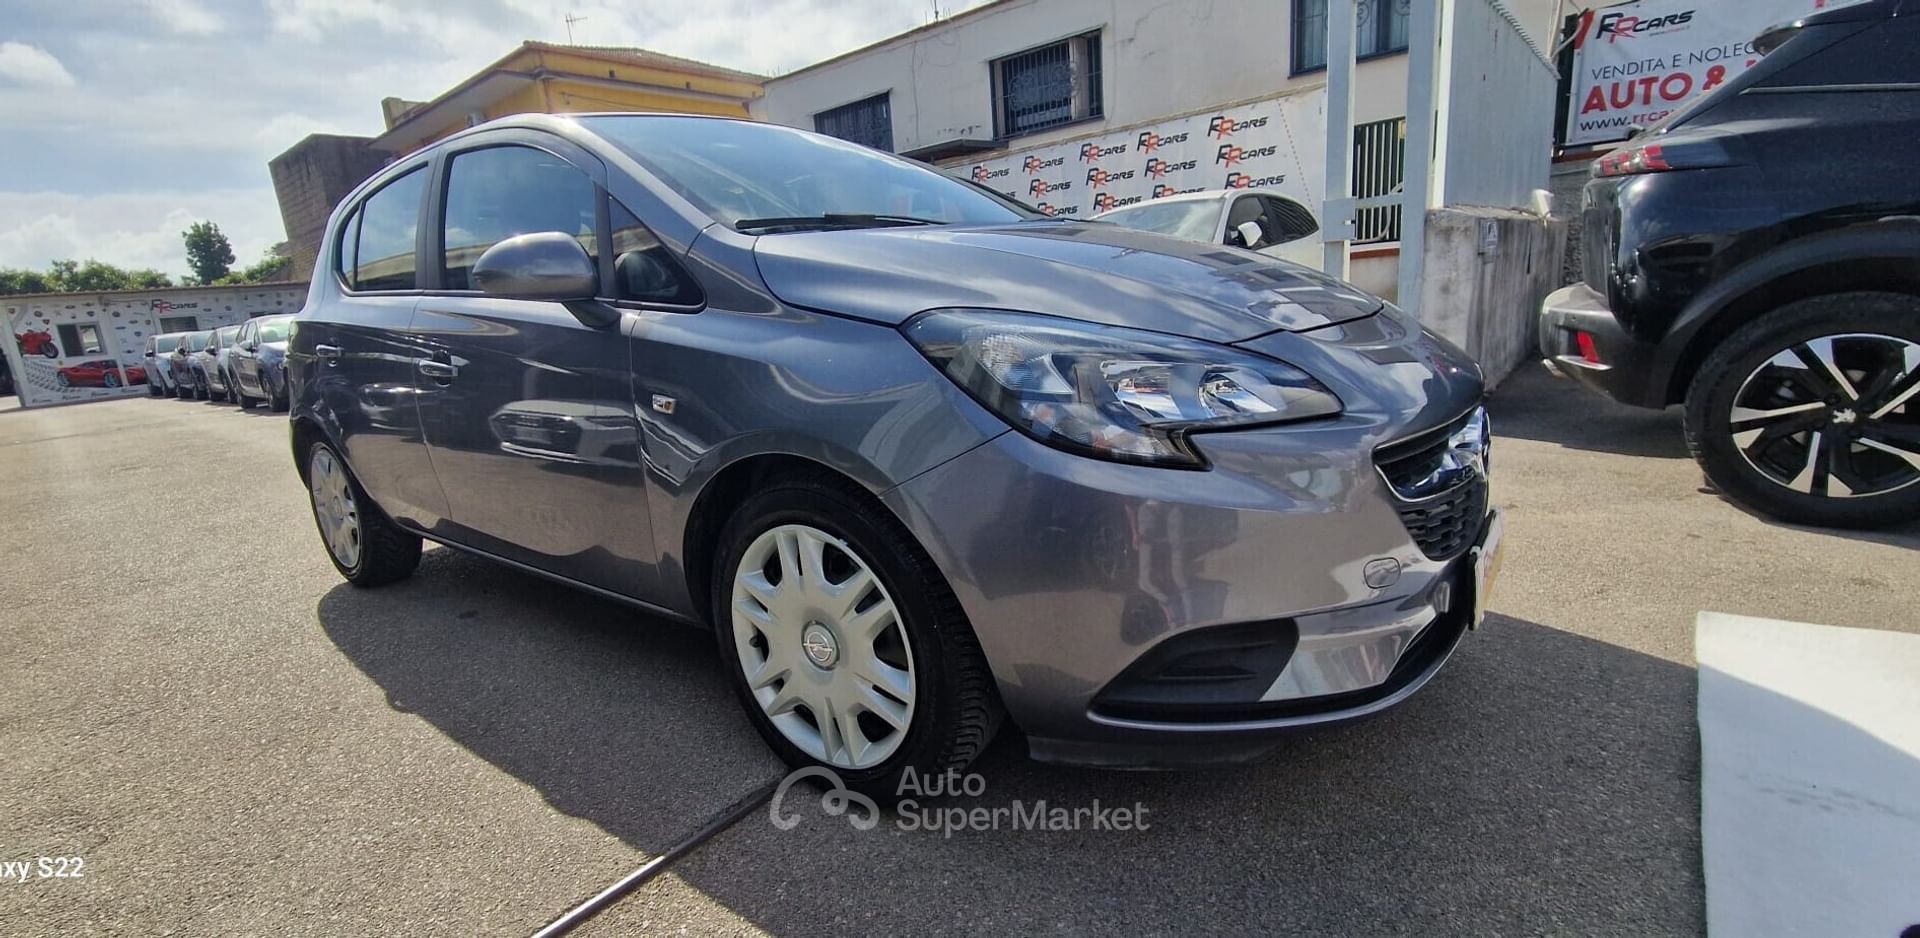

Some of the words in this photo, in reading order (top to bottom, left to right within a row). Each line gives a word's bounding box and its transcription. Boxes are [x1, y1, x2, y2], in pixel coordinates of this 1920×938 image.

[1592, 57, 1665, 80] VENDITA
[1672, 53, 1682, 68] E
[1581, 72, 1693, 114] AUTO
